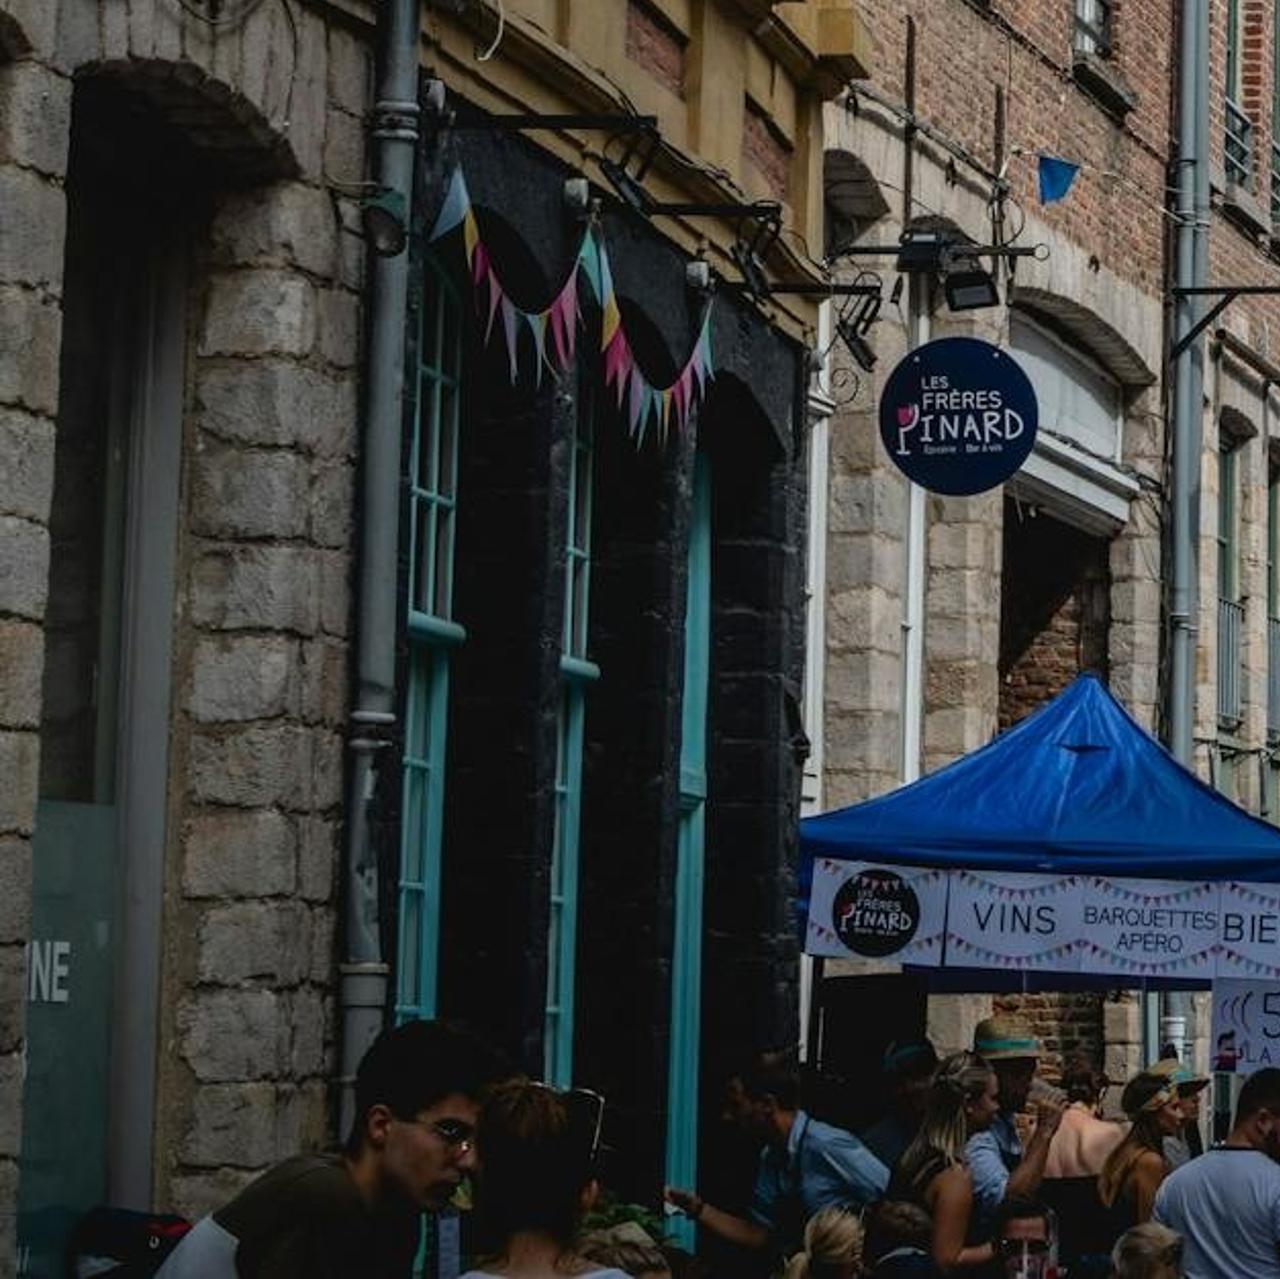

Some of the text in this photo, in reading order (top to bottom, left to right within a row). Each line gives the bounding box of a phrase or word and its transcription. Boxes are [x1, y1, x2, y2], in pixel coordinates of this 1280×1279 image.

[921, 375, 949, 390] LES
[922, 388, 1003, 411] FRÈRES
[972, 900, 1057, 936] VINS
[1083, 905, 1219, 932] BARQUETTES
[1245, 1046, 1272, 1064] LA
